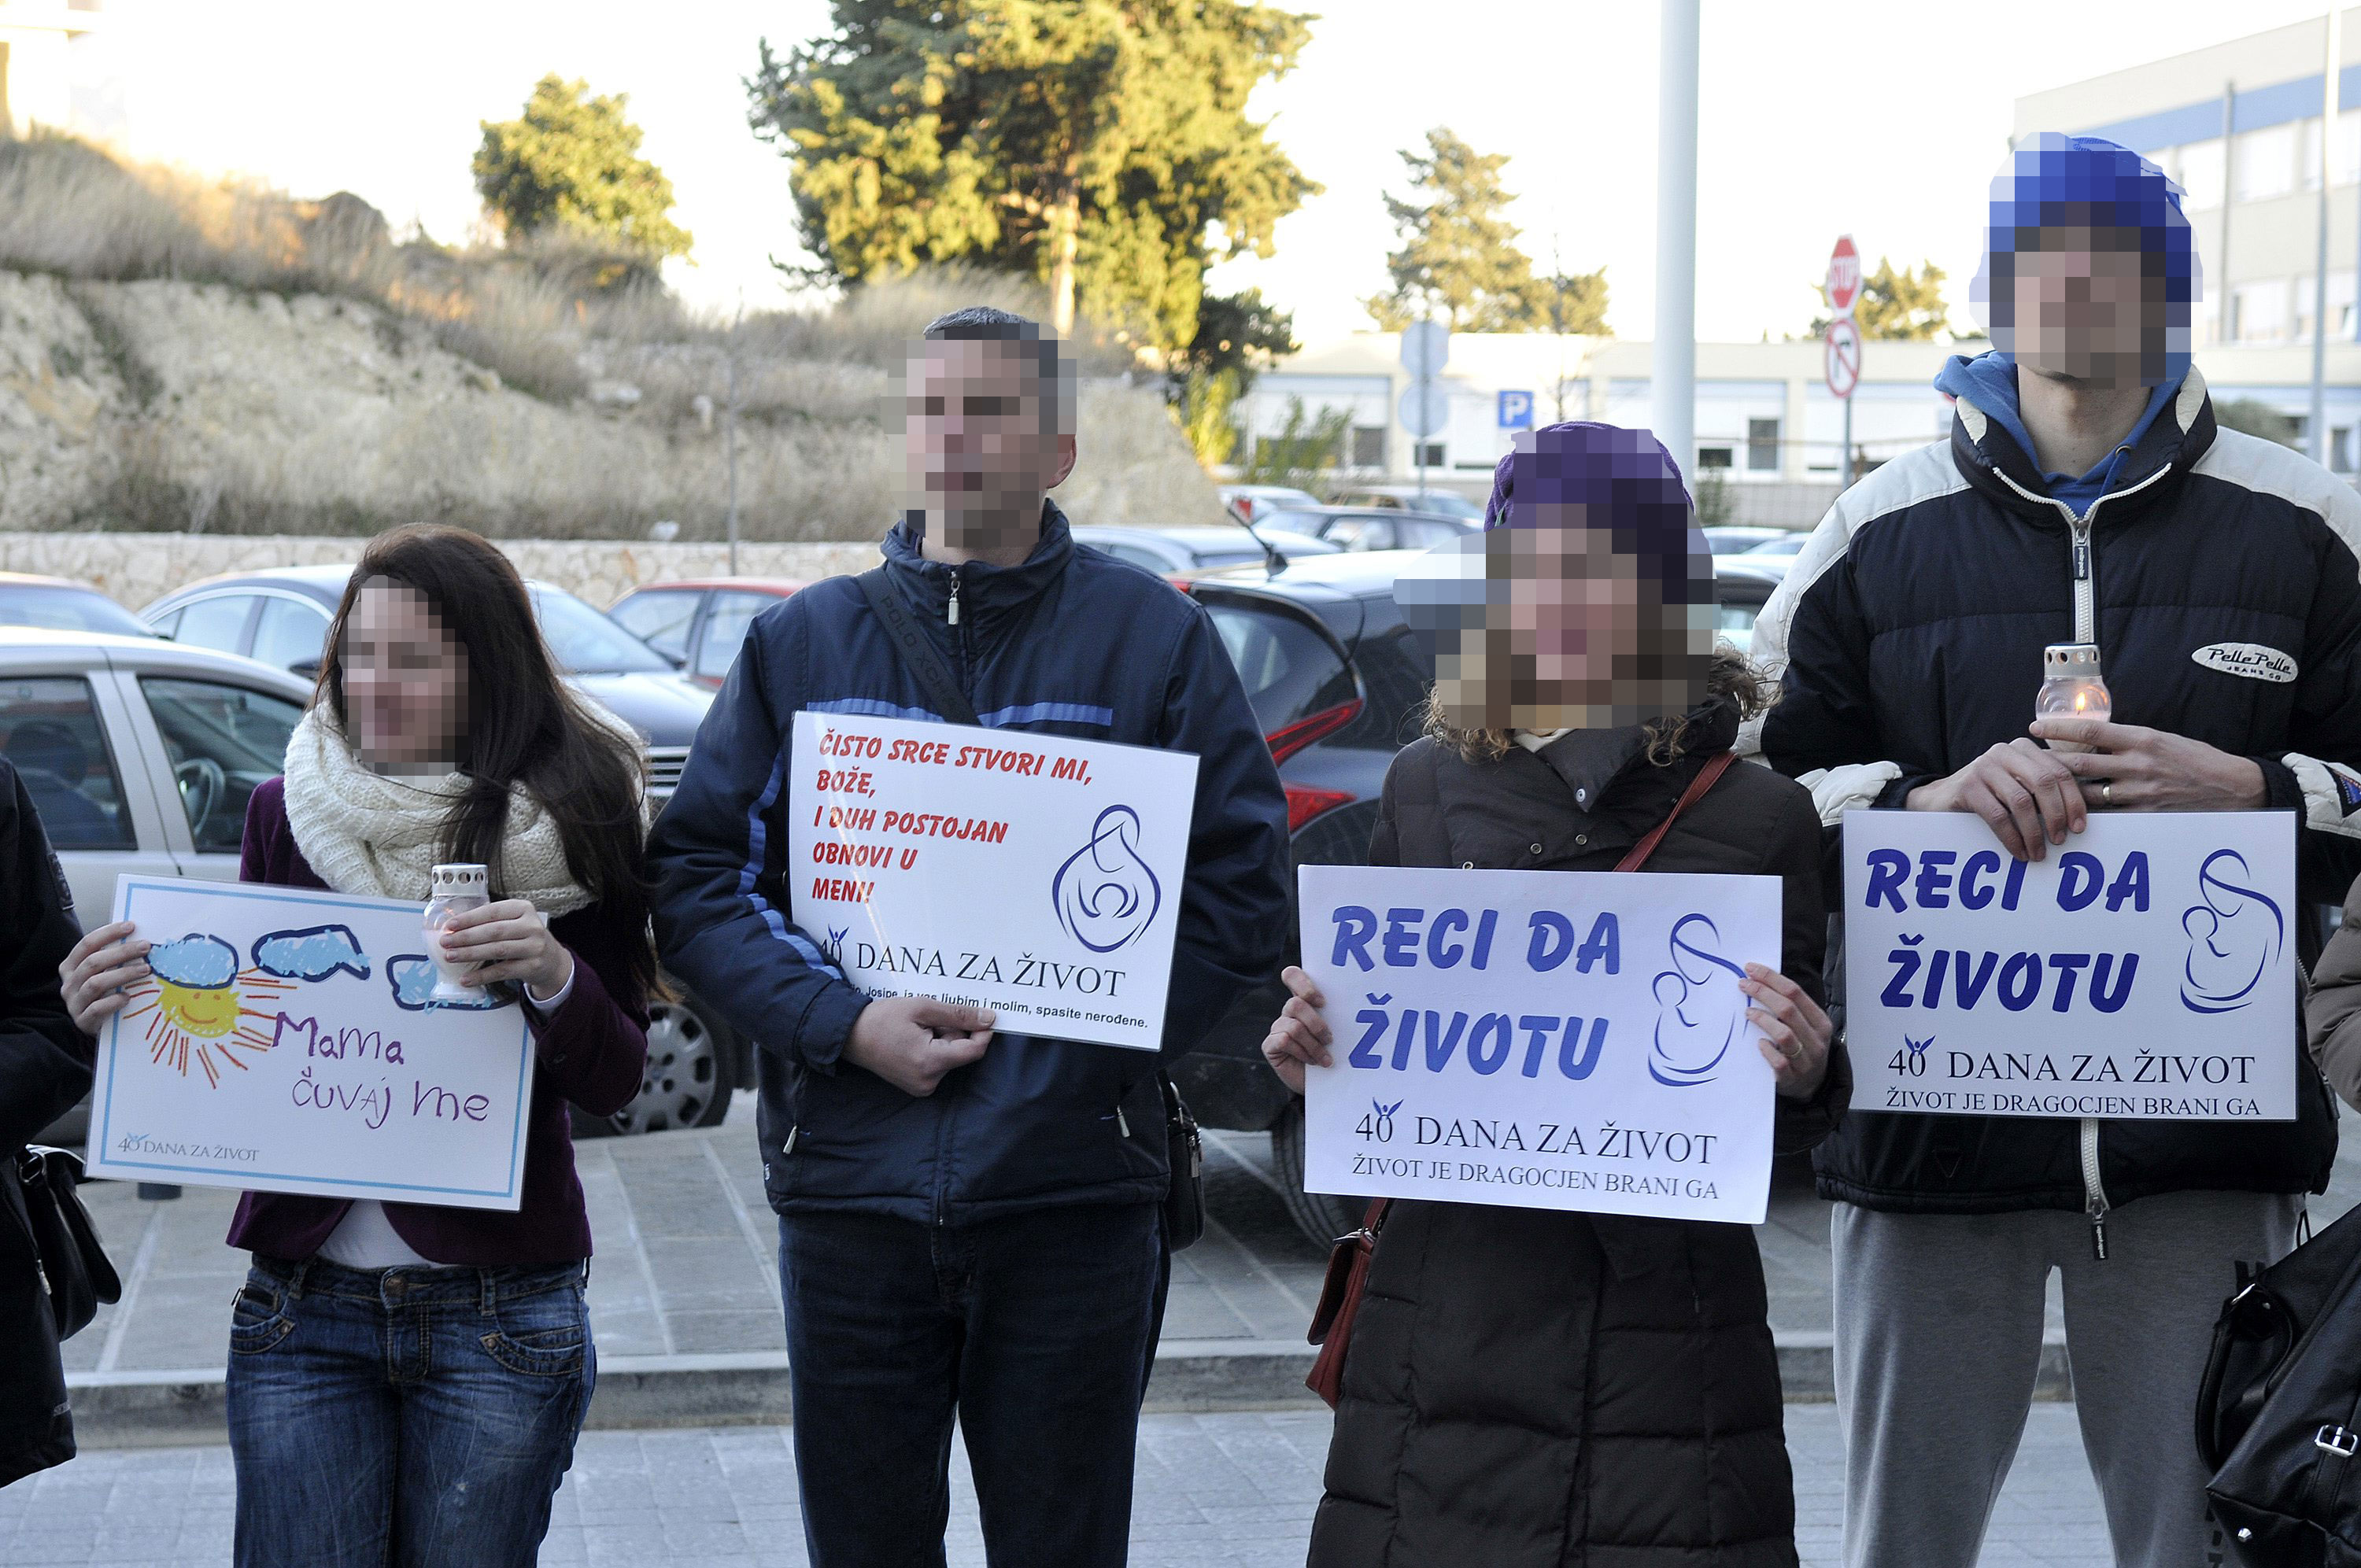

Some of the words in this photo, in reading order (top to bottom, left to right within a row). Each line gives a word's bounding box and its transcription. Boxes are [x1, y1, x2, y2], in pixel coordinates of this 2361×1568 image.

[1505, 393, 1528, 425] P
[2208, 647, 2255, 665] Pelle
[2254, 652, 2292, 675] Pelle
[818, 729, 882, 758] ČISTO
[888, 740, 951, 765] SRCE
[955, 746, 1046, 777] STVORI
[1051, 757, 1093, 786] MI,
[816, 766, 877, 799] BOŽE,
[814, 806, 824, 828] I
[829, 807, 875, 832] DUH
[883, 810, 1009, 844] POSTOJAN
[812, 842, 894, 869] OBNOVI
[900, 848, 918, 870] U
[811, 877, 875, 904] MENI!
[1864, 847, 2029, 914] RECI
[2056, 850, 2151, 913] DA
[1332, 905, 1498, 972] RECI
[1527, 910, 1620, 976] DA
[856, 943, 946, 977] DANA
[955, 952, 1003, 983] ZA
[1011, 952, 1126, 998] ŽIVOT
[1879, 933, 2140, 1014] ŽIVOTU
[990, 1000, 1032, 1016] molim,
[1035, 1006, 1081, 1020] spasite
[1084, 1012, 1148, 1029] nerođene.
[272, 1012, 405, 1065] Mama
[1348, 992, 1609, 1082] ŽIVOTU
[1888, 1042, 1928, 1077] 40
[1947, 1051, 2060, 1083] DANA
[2071, 1055, 2124, 1083] ZA
[2132, 1047, 2256, 1084] ŽIVOT
[412, 1080, 490, 1122] me
[1886, 1086, 1956, 1110] ŽIVOT
[1963, 1093, 1987, 1110] JE
[1993, 1094, 2137, 1116] DRAGOCJEN
[2143, 1098, 2219, 1116] BRANI
[2226, 1098, 2262, 1116] GA
[144, 1141, 187, 1156] DANA
[190, 1145, 210, 1158] ZA
[213, 1145, 260, 1161] ŽIVOT
[1355, 1108, 1395, 1143] 40
[1414, 1116, 1528, 1153] DANA
[1536, 1123, 1590, 1157] ZA
[1597, 1120, 1717, 1165] ŽIVOT
[1352, 1152, 1423, 1179] ŽIVOT
[1428, 1160, 1452, 1180] JE
[1458, 1163, 1600, 1191] DRAGOCJEN
[1604, 1173, 1679, 1197] BRANI
[1685, 1178, 1720, 1200] GA
